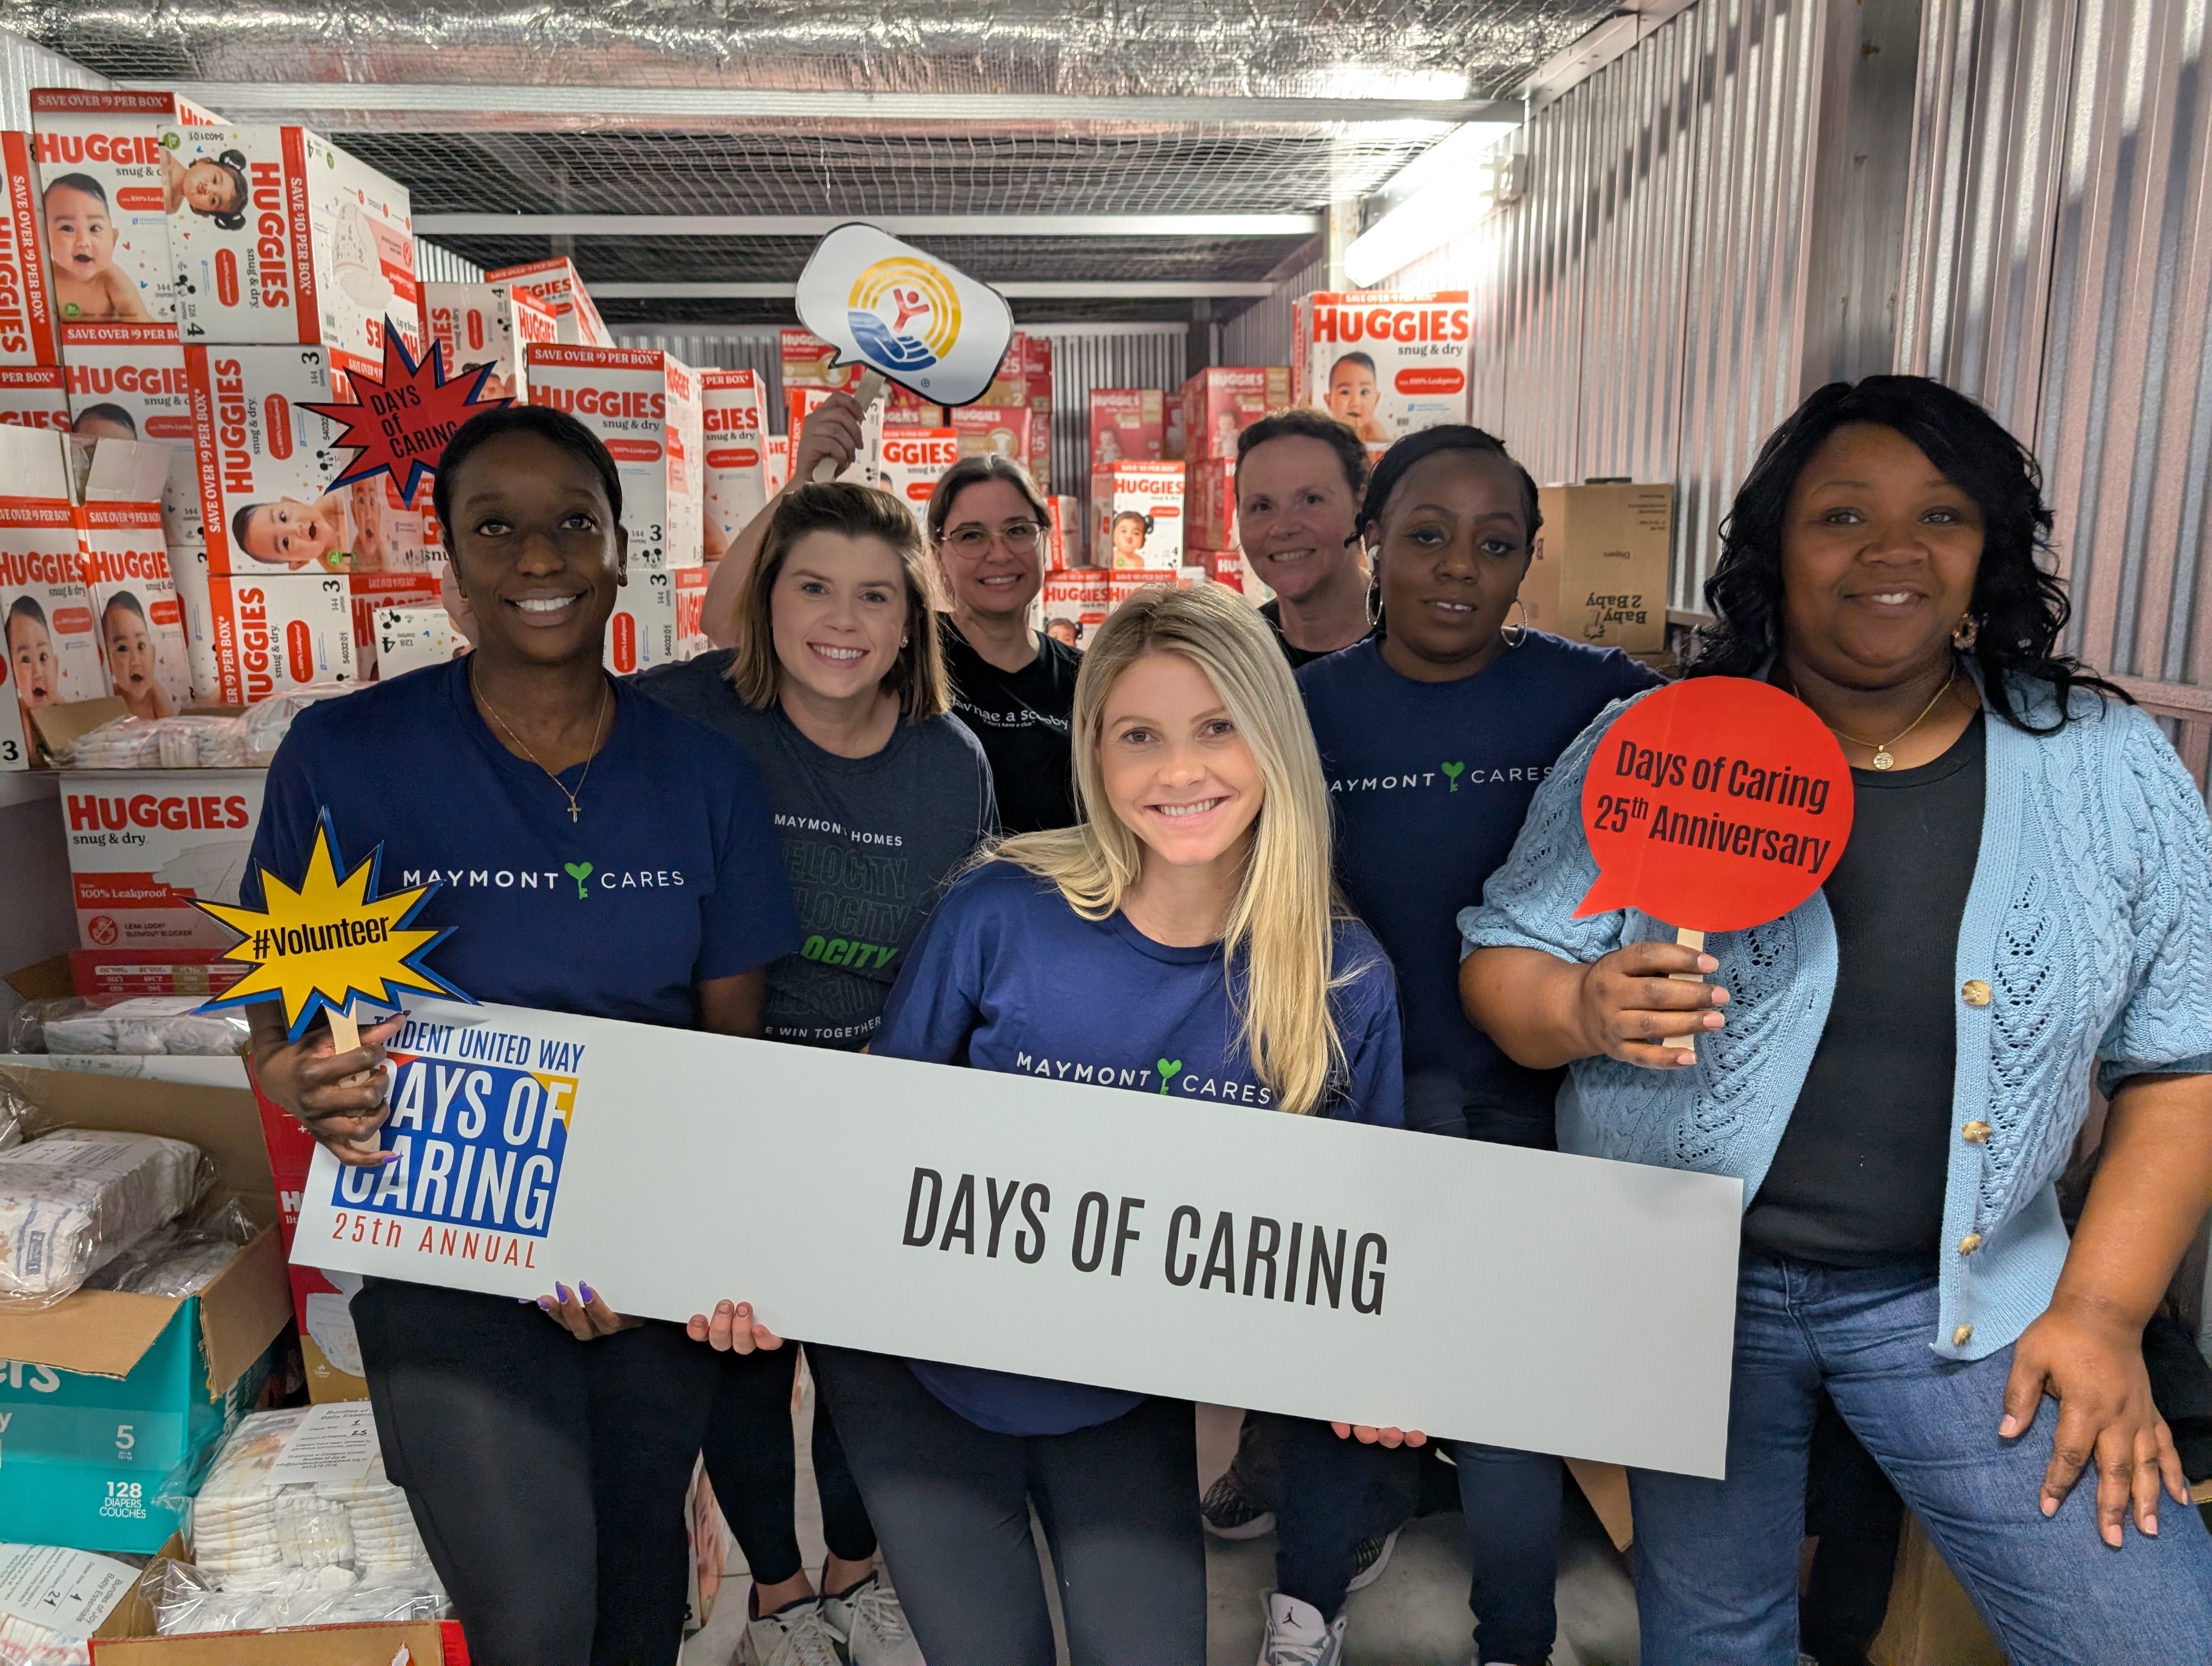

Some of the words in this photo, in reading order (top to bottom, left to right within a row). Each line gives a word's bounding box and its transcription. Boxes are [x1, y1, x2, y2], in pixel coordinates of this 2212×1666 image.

[38, 96, 66, 106] SAVE
[69, 96, 99, 106] OVER
[114, 97, 137, 107] PER
[116, 167, 143, 178] snug
[146, 167, 155, 175] &
[13, 176, 29, 209] SAVE
[291, 178, 305, 212] SAVE
[19, 211, 34, 247] OVER
[250, 163, 290, 308] HUGGIES
[297, 234, 310, 263] PER
[247, 248, 255, 276] snug
[27, 262, 40, 289] PER
[250, 278, 257, 286] &
[250, 287, 259, 309] dry
[187, 304, 196, 318] 128
[68, 329, 96, 339] SAVE
[98, 329, 129, 339] OVER
[144, 330, 165, 339] PER
[187, 323, 205, 337] 4
[1314, 308, 1469, 343] HUGGIES
[301, 351, 320, 366] 3
[535, 349, 562, 360] SAVE
[564, 350, 594, 362] OVER
[608, 353, 628, 364] PER
[1398, 345, 1427, 356] snug
[1430, 344, 1440, 354] &
[1442, 343, 1463, 356] dry
[706, 375, 724, 385] PER
[144, 397, 171, 407] snug
[173, 397, 184, 406] &
[247, 398, 257, 417] dry
[370, 385, 421, 416] DAYS
[529, 385, 666, 419] HUGGIES
[215, 358, 254, 493] HUGGIES
[251, 418, 258, 428] &
[381, 412, 402, 437] of
[602, 419, 628, 430] snug
[631, 420, 639, 428] &
[641, 420, 660, 432] dry
[198, 421, 211, 448] PER
[249, 427, 261, 454] snug
[739, 432, 755, 440] dry
[204, 463, 217, 500] OVER
[1114, 478, 1185, 494] HUGGIES
[209, 501, 221, 533] SAVE
[650, 524, 661, 541] 3
[323, 580, 340, 592] 3
[650, 574, 667, 586] 3
[1044, 587, 1109, 601] HUGGIES
[1585, 592, 1630, 609] Baby
[1632, 595, 1642, 608] 2
[1603, 610, 1648, 624] Baby
[270, 625, 280, 643] dry
[272, 645, 280, 653] &
[382, 637, 395, 653] 4
[222, 649, 235, 673] PER
[273, 654, 282, 679] snug
[1006, 712, 1015, 721] a
[2, 741, 19, 761] 3
[1471, 766, 1555, 784] CARES
[1616, 740, 1688, 788] Days
[1692, 756, 1727, 792] of
[1728, 760, 1831, 815] Caring
[67, 794, 249, 831] HUGGIES
[73, 834, 106, 846] snug
[109, 833, 119, 844] &
[123, 832, 146, 846] dry
[851, 830, 903, 846] HOMES
[1594, 794, 1649, 833] 25th
[1648, 805, 1831, 874] Anniversary
[403, 869, 559, 889] MAYMONT
[600, 871, 685, 889] CARES
[81, 889, 110, 898] 100%
[112, 888, 166, 899] Leakproof
[252, 916, 390, 959] #Volunteer
[800, 934, 899, 969] OCITY
[779, 1027, 808, 1038] WIN
[814, 1016, 882, 1039] TOGETHER
[459, 1028, 532, 1066] UNITED
[539, 1039, 586, 1074] WAY
[1017, 1051, 1152, 1087] MAYMONT
[1182, 1075, 1272, 1105] CARES
[503, 1077, 573, 1150] OF
[340, 1135, 554, 1231] CARING
[332, 1212, 402, 1248] 25th
[418, 1225, 537, 1269] ANNUAL
[902, 1167, 1051, 1265] DAYS
[1071, 1190, 1146, 1277] OF
[1164, 1203, 1388, 1316] CARING
[115, 1424, 135, 1450] 5
[107, 1481, 143, 1498] 128
[105, 1497, 142, 1508] DIAPERS
[99, 1507, 146, 1519] COUCHES
[98, 1572, 114, 1590] Baby
[101, 1578, 123, 1604] Bundles
[75, 1589, 102, 1623] Essentials
[96, 1603, 105, 1612] of
[85, 1611, 99, 1625] Joy
